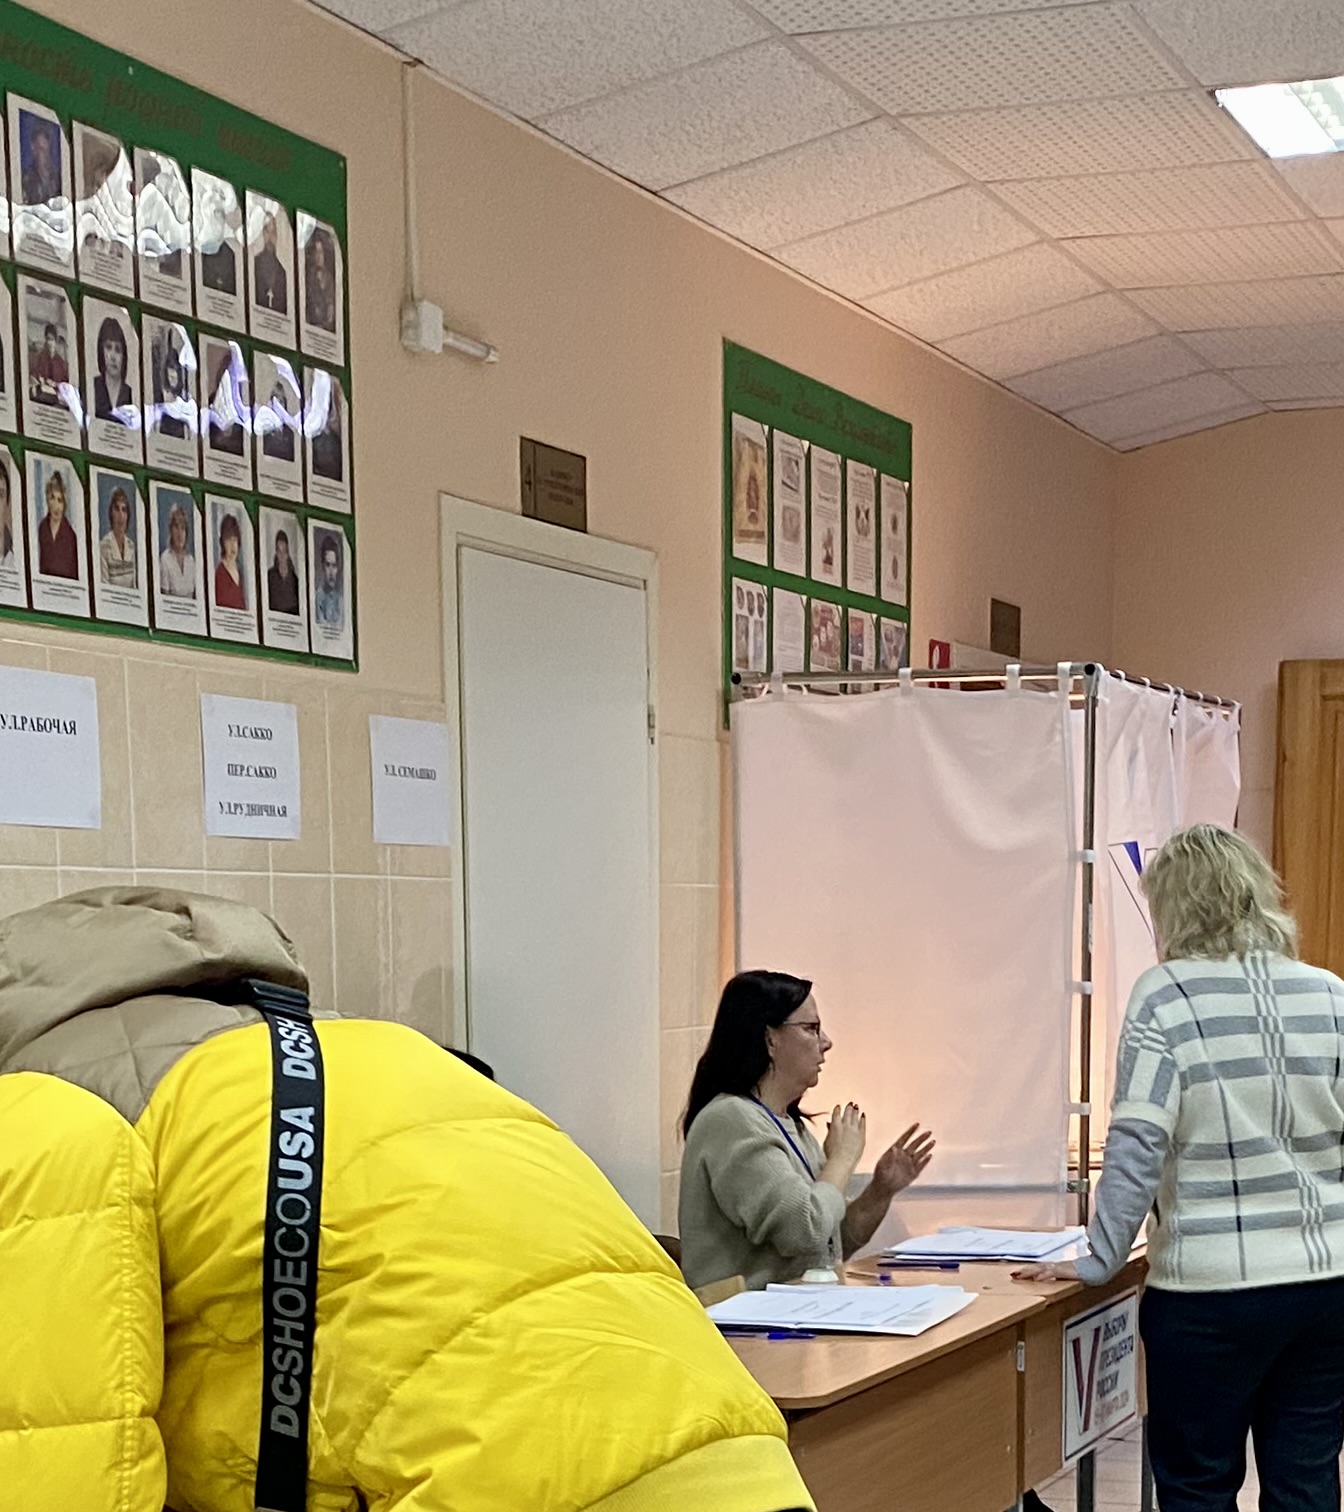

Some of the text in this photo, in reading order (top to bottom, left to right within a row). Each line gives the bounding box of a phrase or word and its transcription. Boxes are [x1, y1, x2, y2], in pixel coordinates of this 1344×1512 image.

[0, 713, 77, 736] УЛ.РАБОЧАЯ
[227, 763, 277, 780] ПЕР.САККО
[270, 1106, 316, 1439] DCSHOECOUSA
